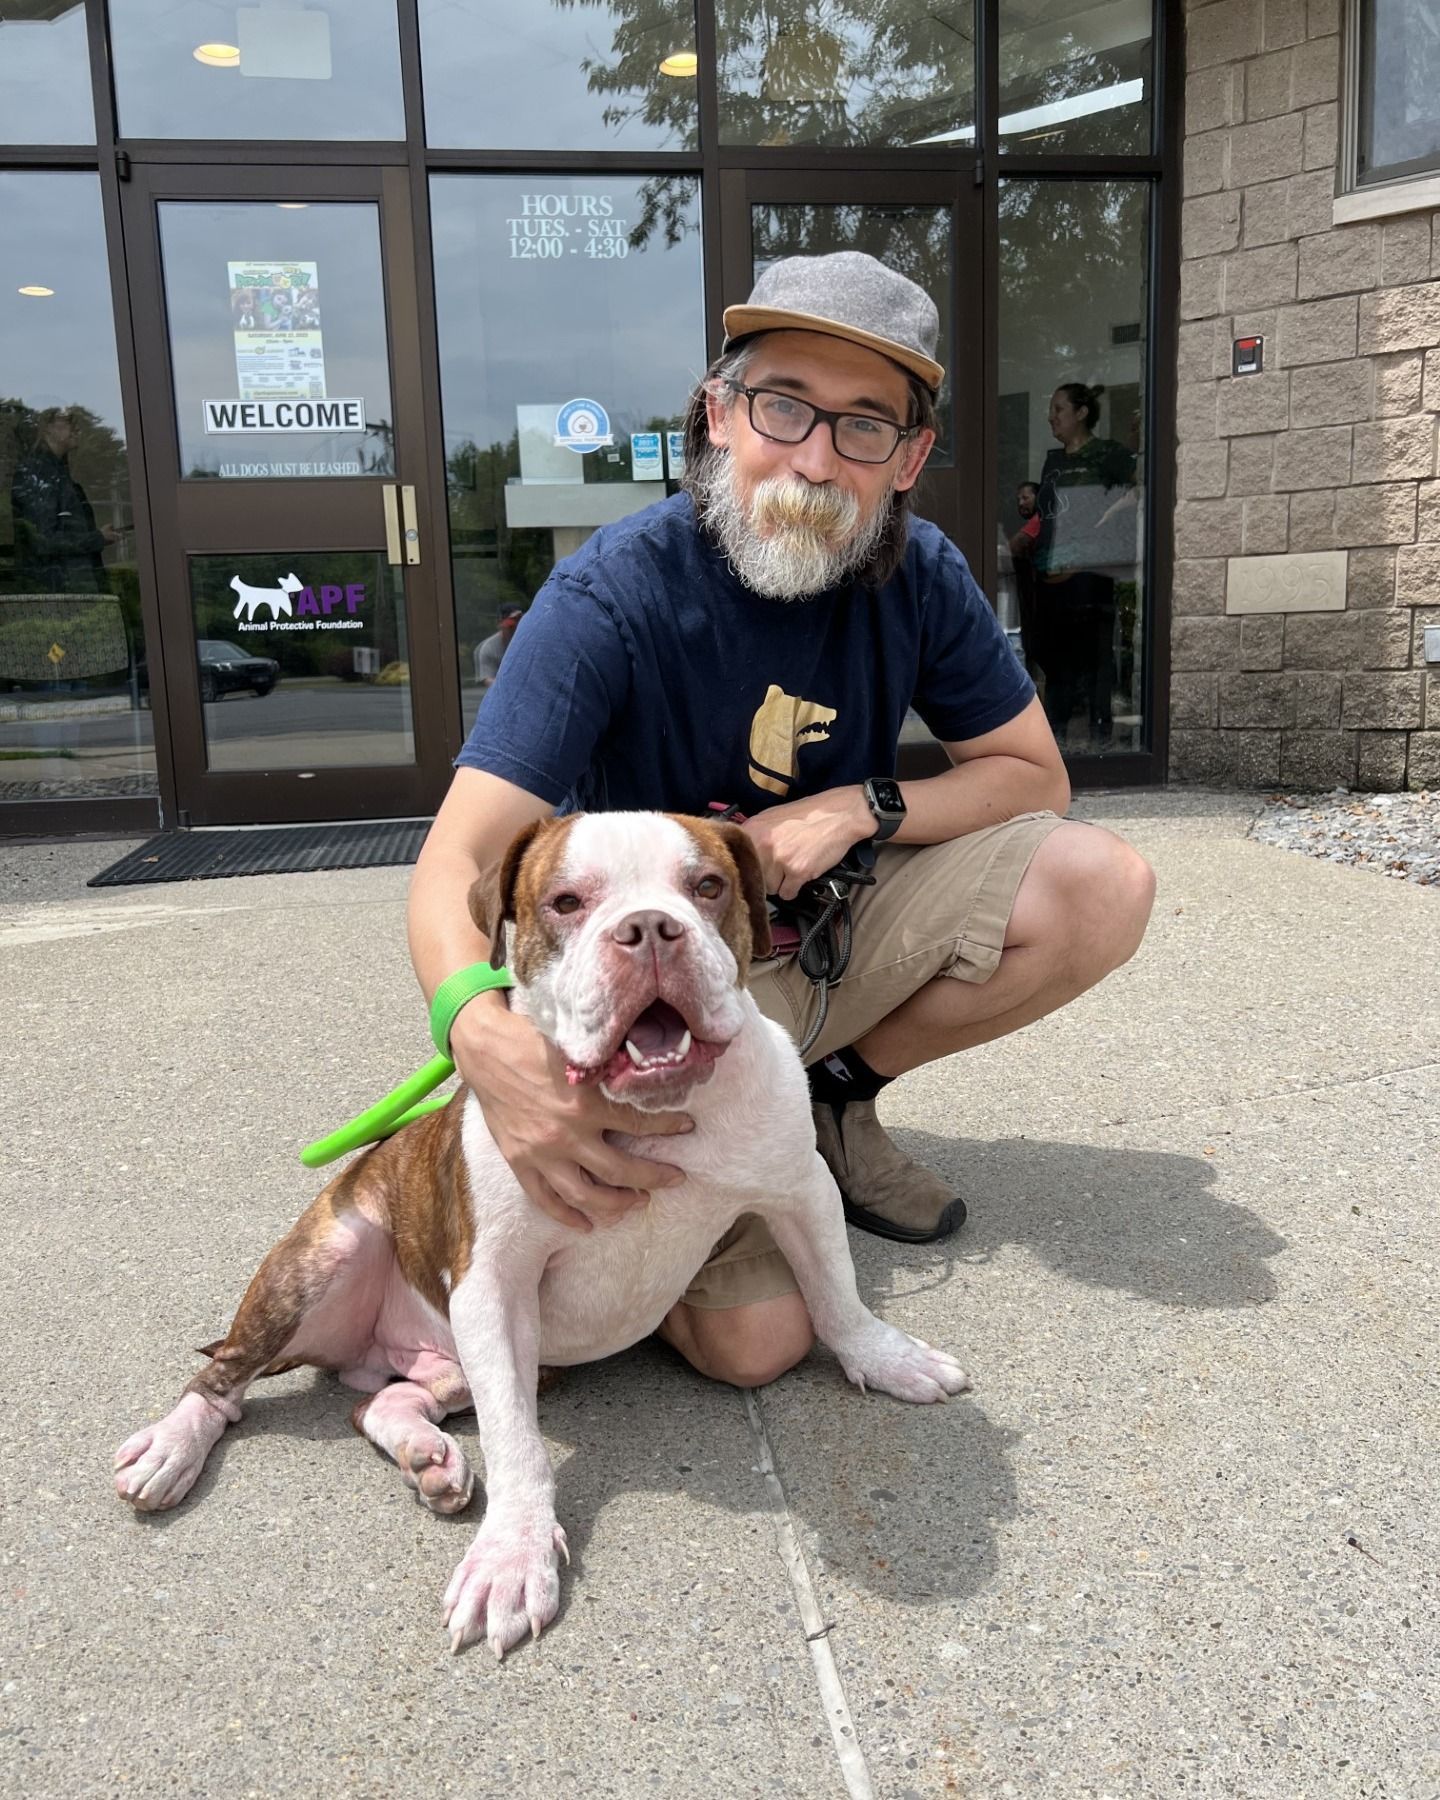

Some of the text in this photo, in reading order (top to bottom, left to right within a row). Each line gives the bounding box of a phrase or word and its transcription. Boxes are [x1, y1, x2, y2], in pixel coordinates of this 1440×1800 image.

[521, 194, 613, 217] HOURS
[506, 218, 570, 238] TUES.
[588, 219, 627, 238] SAT
[508, 237, 563, 259] 12:00
[584, 237, 629, 259] 4:30
[209, 402, 360, 428] WELCOME
[219, 462, 360, 476] ALL DOGS MUST BE LEASHED
[297, 583, 366, 616] APF
[238, 619, 363, 631] Animal Protective Foundation
